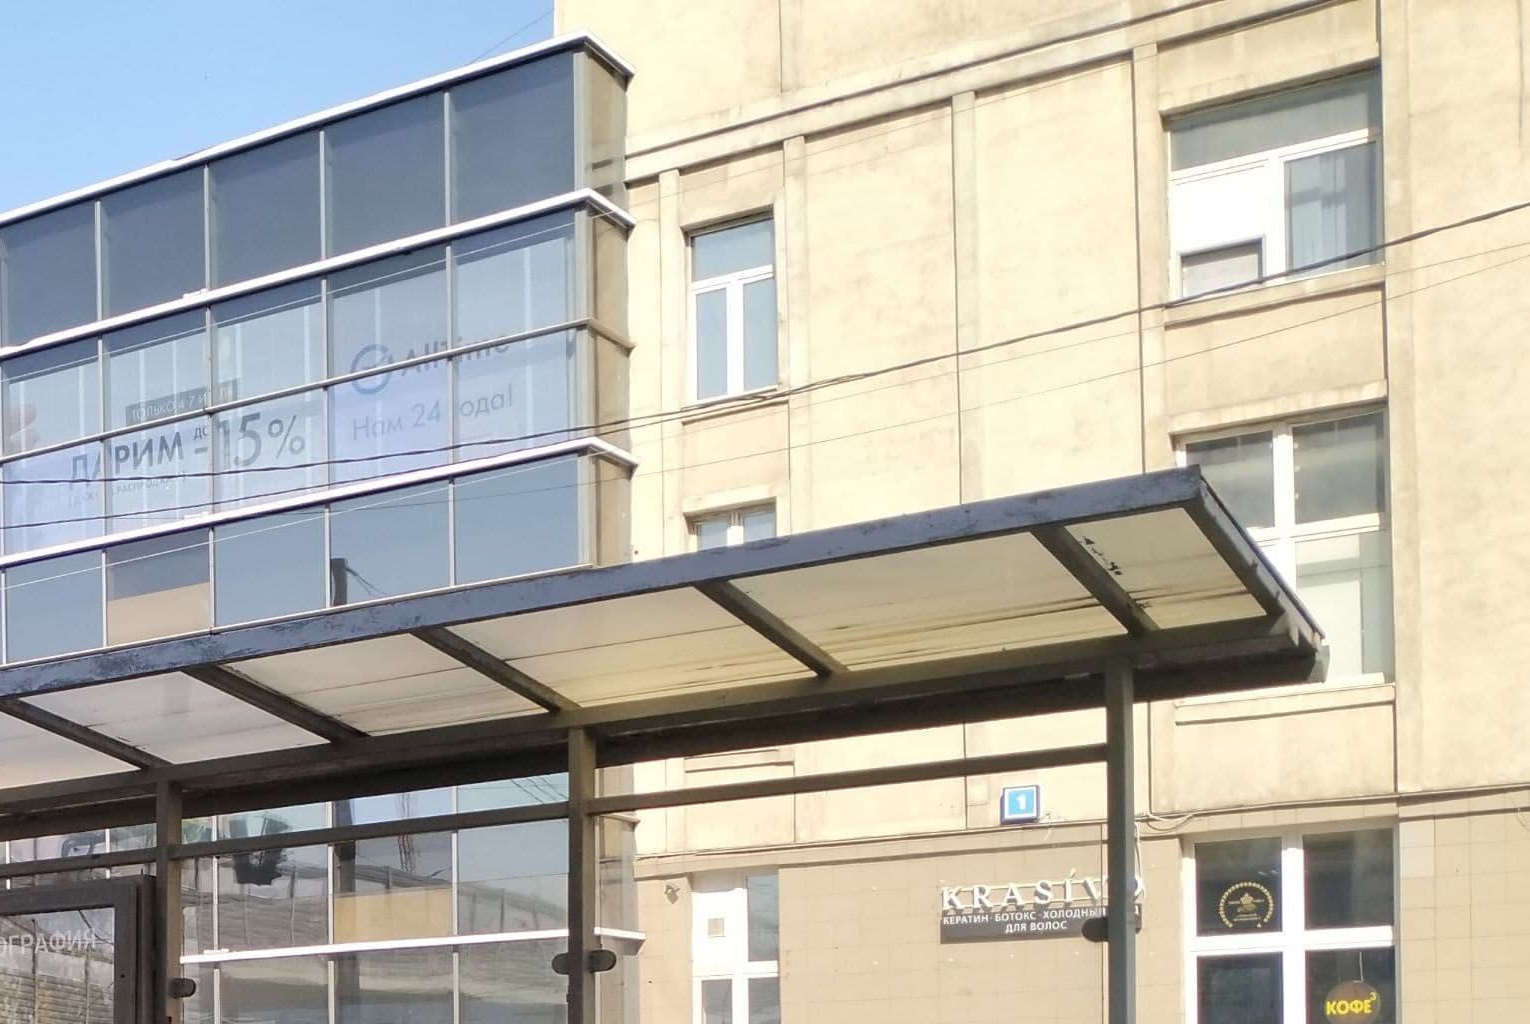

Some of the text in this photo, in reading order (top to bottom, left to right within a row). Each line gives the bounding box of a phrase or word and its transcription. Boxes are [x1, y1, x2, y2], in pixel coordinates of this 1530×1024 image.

[352, 383, 513, 441] Нам 24 ода!
[1015, 794, 1027, 811] 1
[941, 867, 1144, 910] KRASÍV
[943, 914, 989, 925] КЕРАТИН
[994, 911, 1037, 922] БОТОКС
[1005, 920, 1068, 934] ДЛЯ ВОЛОС
